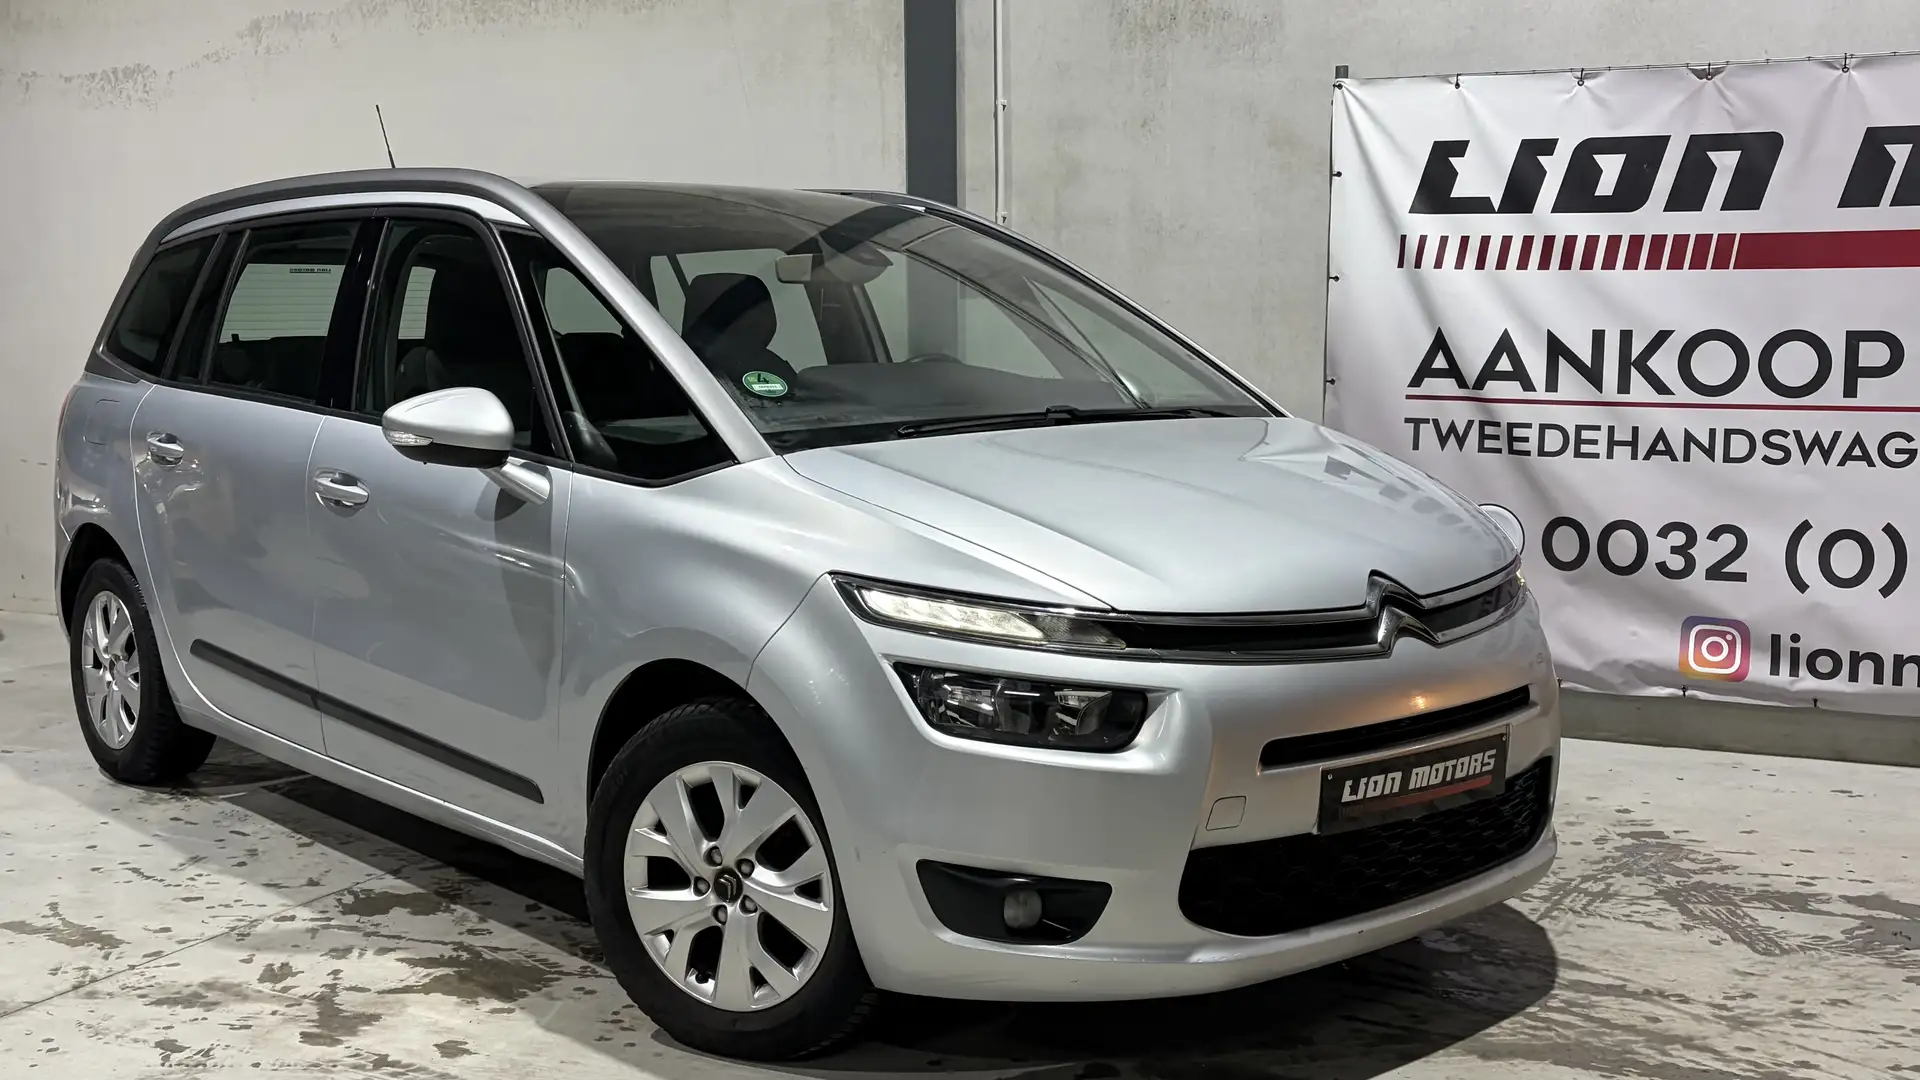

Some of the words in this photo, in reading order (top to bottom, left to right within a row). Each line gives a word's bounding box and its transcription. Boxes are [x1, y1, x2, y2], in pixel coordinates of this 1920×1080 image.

[1408, 130, 1785, 214] LION
[1406, 326, 1906, 399] AANKOOP
[1404, 417, 1918, 469] TWEEDEHANDSWAG
[1541, 516, 1748, 583] 0032
[1785, 518, 1908, 599] (0)
[1341, 771, 1402, 803] LION
[1408, 749, 1497, 790] MOTORS
